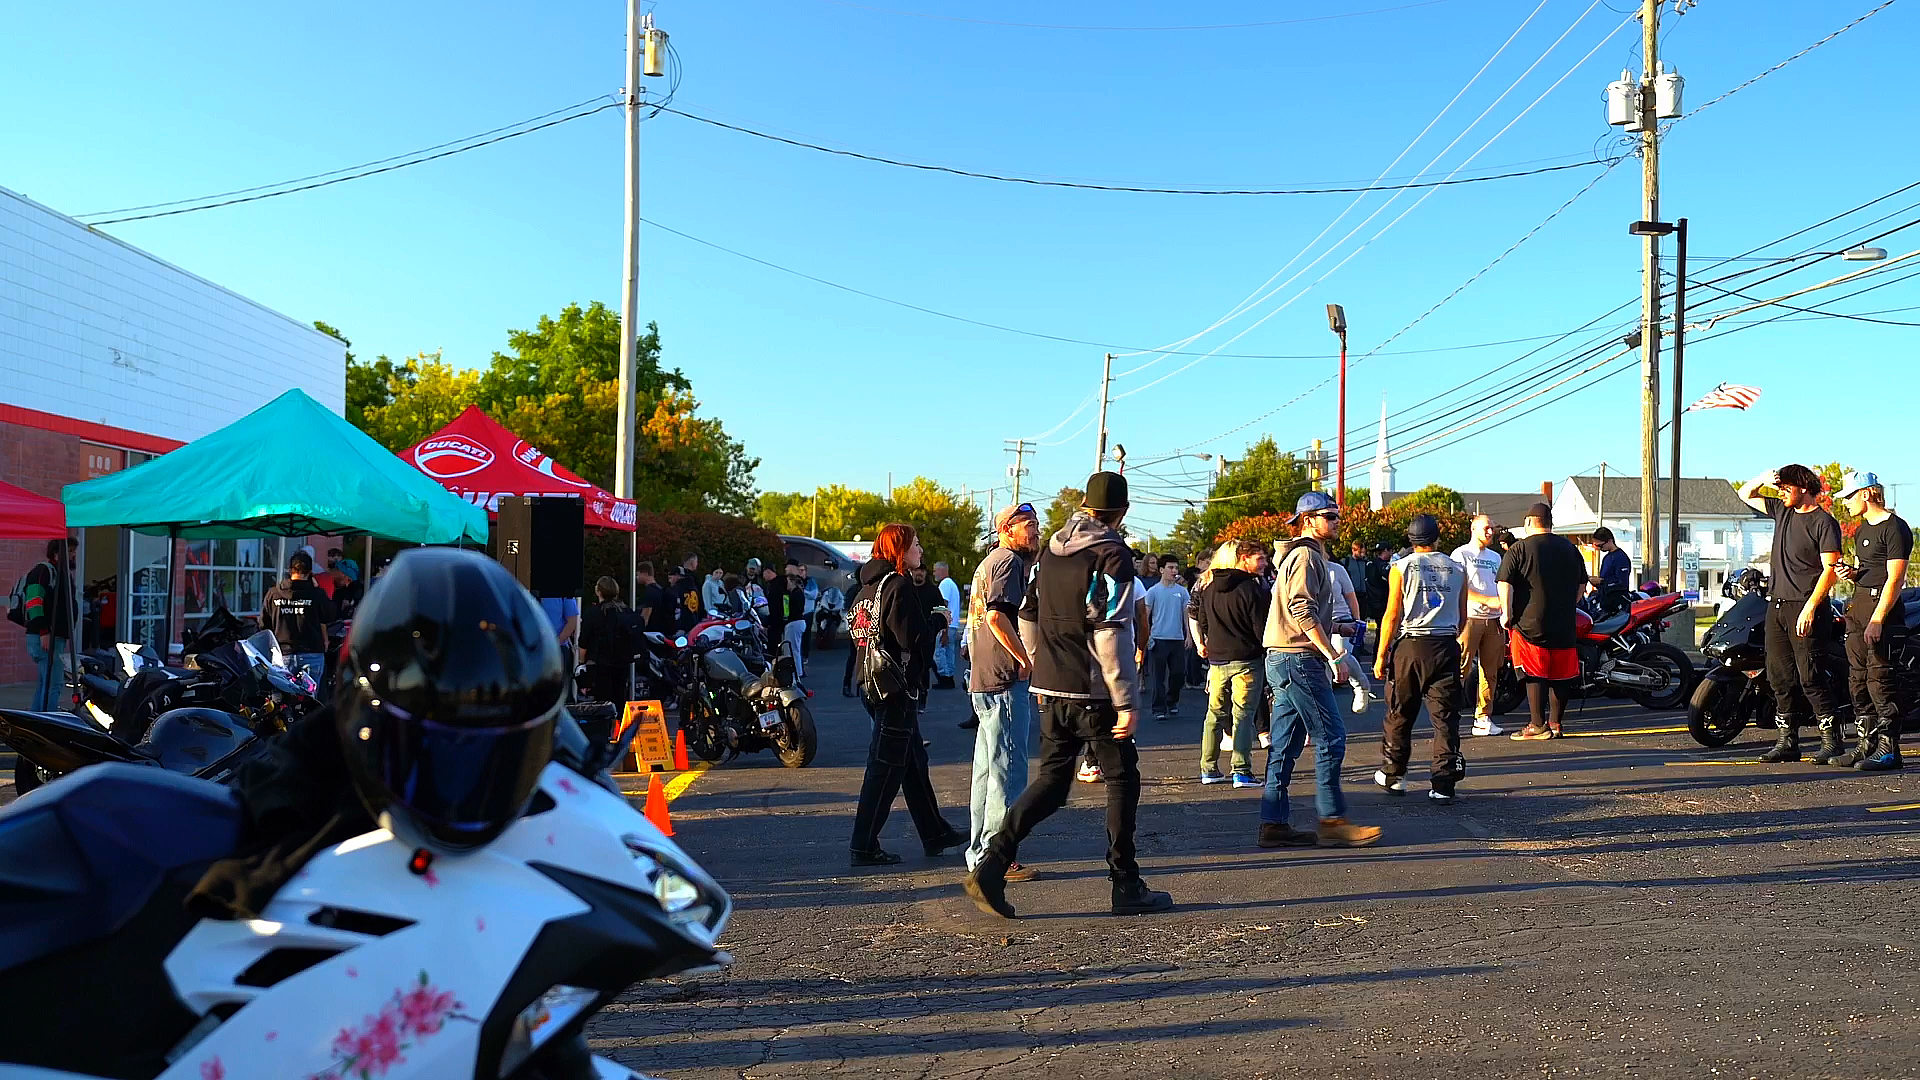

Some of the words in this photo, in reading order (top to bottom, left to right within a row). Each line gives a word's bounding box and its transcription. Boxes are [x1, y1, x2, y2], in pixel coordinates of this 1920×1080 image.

[424, 441, 486, 457] DUCATI
[1685, 562, 1698, 570] 35
[281, 607, 293, 615] YOU
